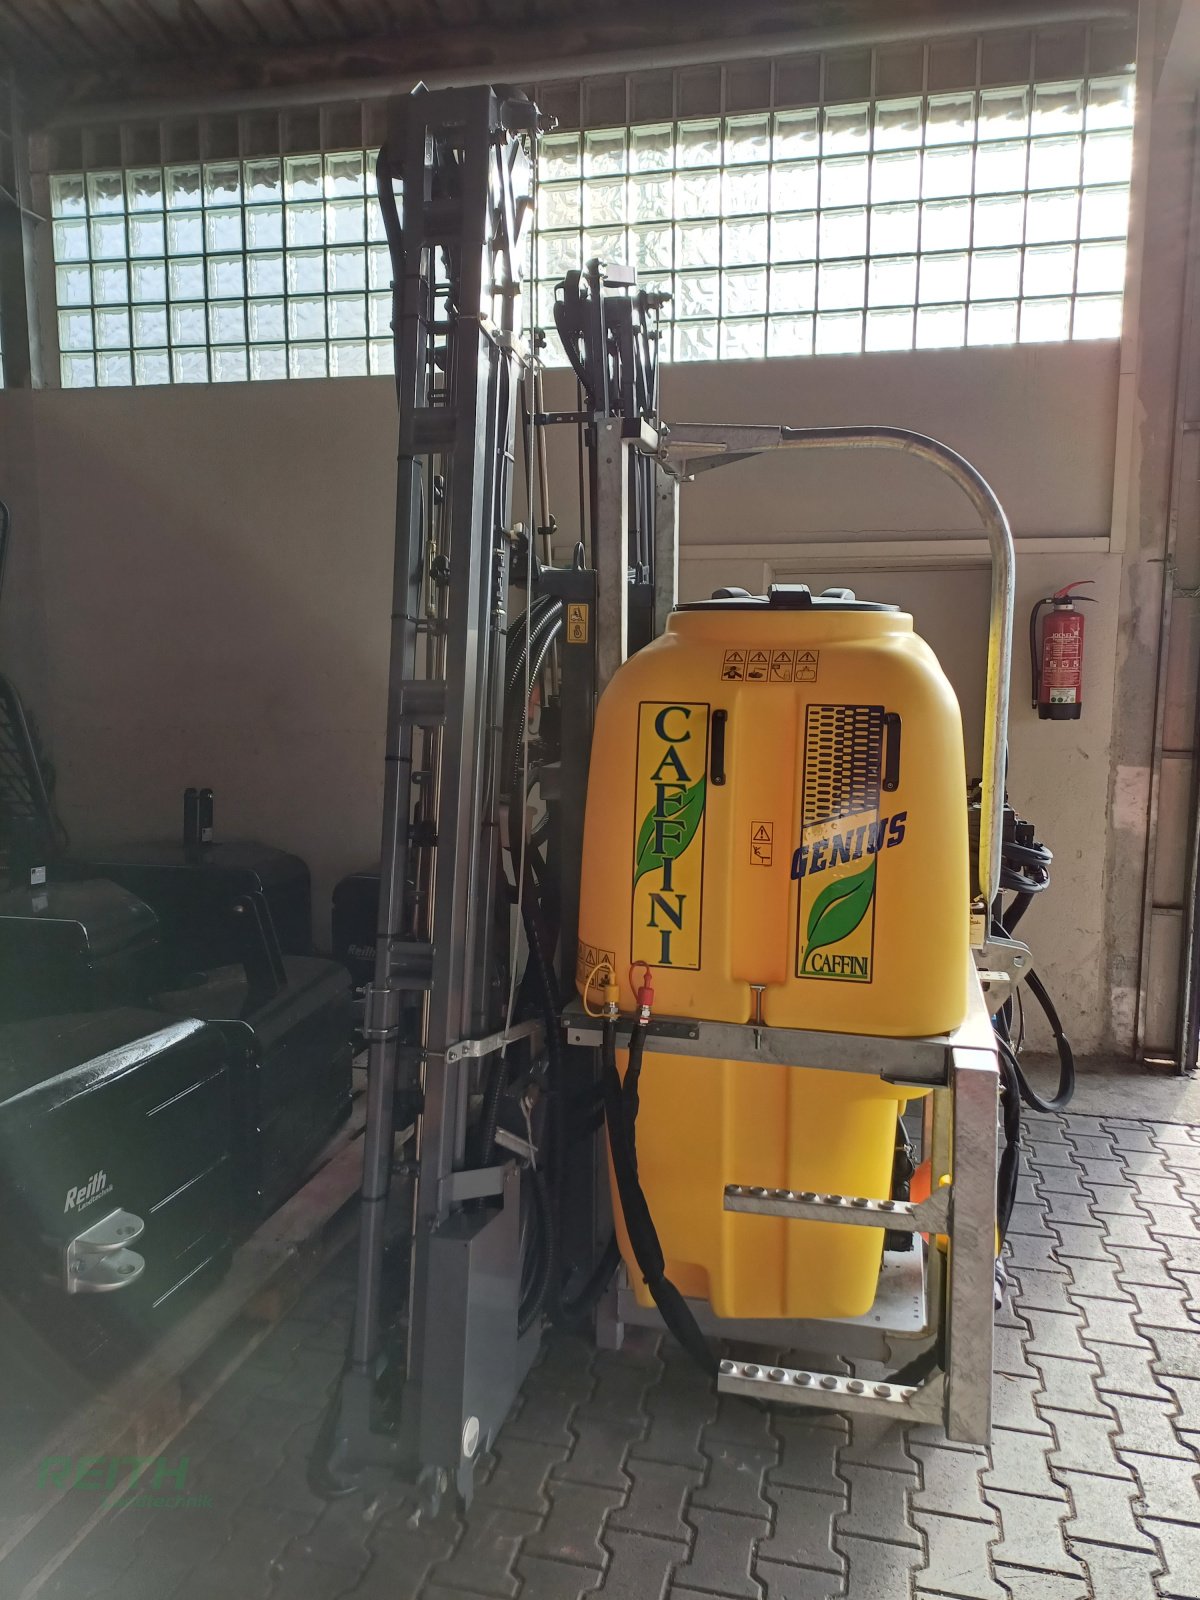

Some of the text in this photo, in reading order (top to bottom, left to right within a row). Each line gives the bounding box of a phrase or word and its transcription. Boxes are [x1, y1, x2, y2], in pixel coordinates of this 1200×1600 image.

[647, 706, 692, 965] CAFFINI
[791, 811, 907, 881] GENIUS
[811, 953, 869, 975] CAFFINI
[64, 1170, 107, 1214] Reith
